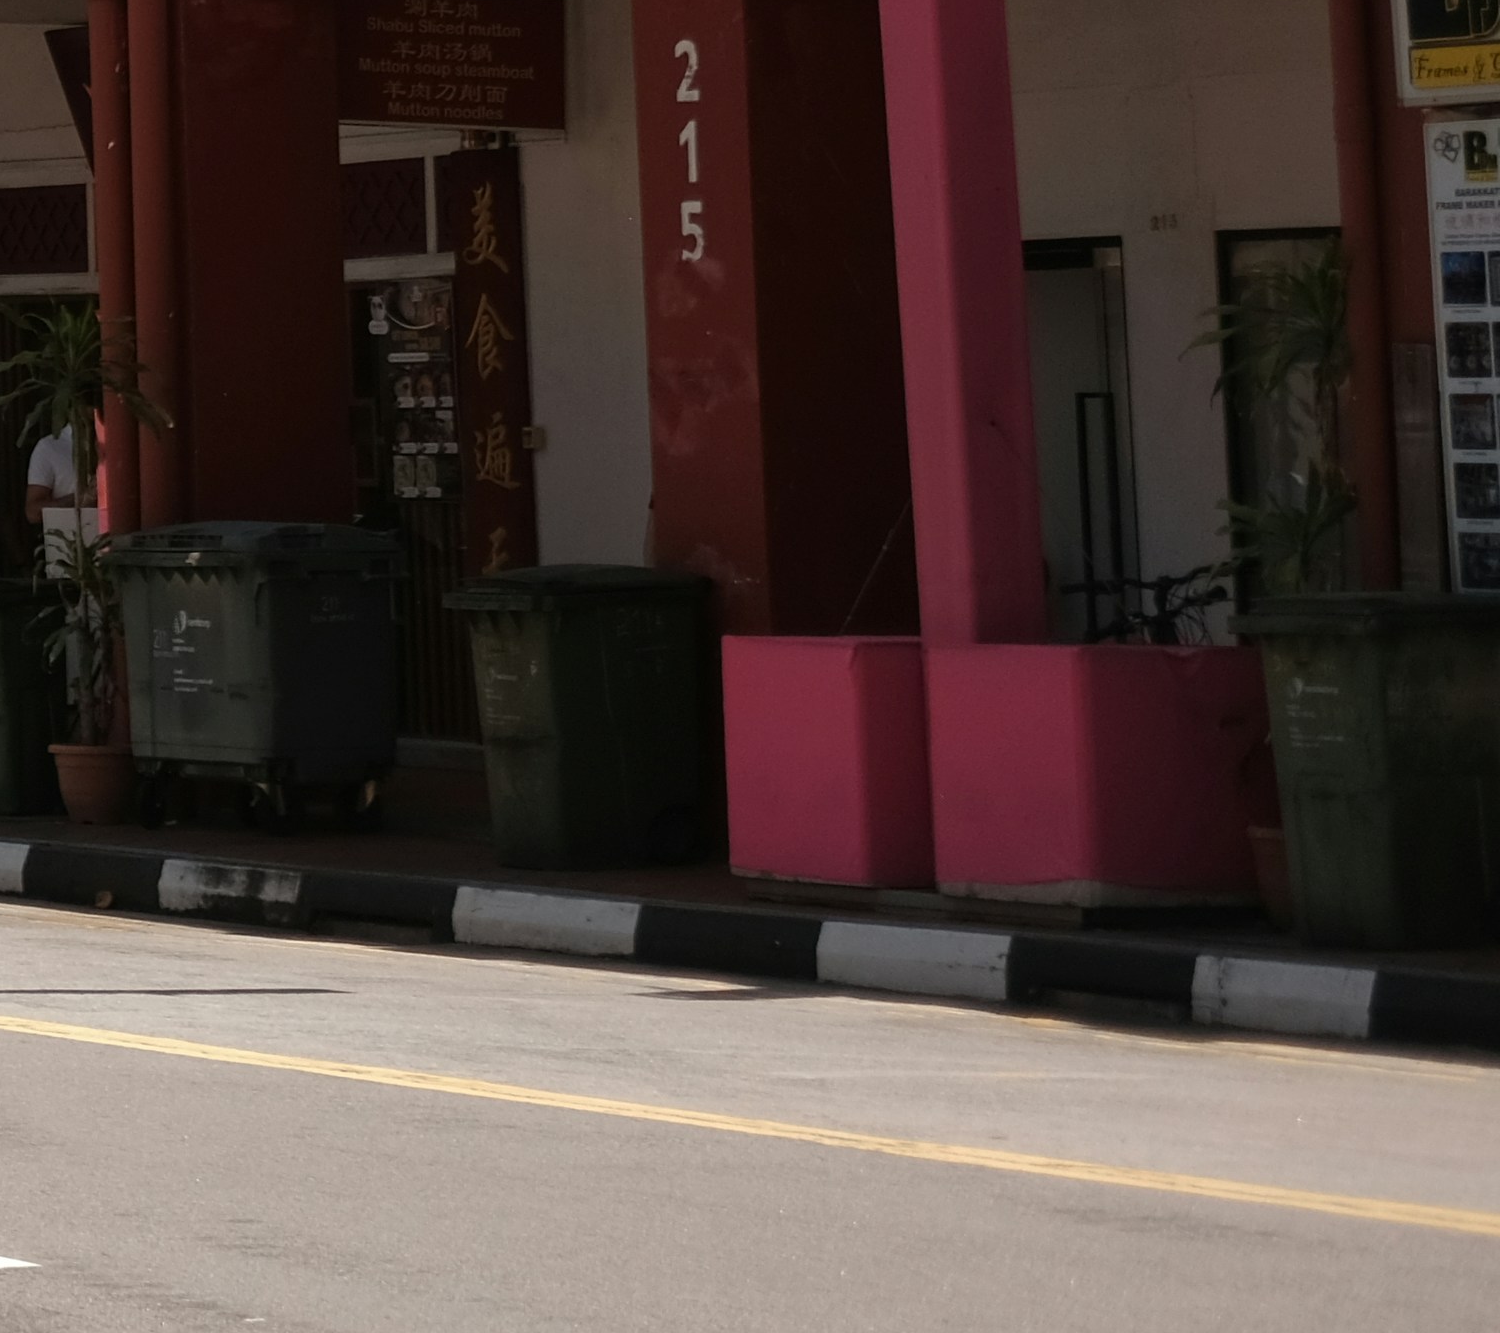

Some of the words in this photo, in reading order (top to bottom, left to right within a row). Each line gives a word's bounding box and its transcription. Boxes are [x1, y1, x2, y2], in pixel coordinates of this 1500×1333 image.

[366, 17, 414, 33] Shabu
[418, 19, 465, 35] Sliced
[468, 23, 522, 38] mutton
[358, 57, 410, 74] Mutton
[414, 63, 451, 78] soup
[454, 62, 535, 81] steamboat
[1415, 56, 1469, 81] Frames
[387, 101, 440, 118] Mutton
[444, 104, 504, 120] noodles
[674, 39, 705, 262] 215
